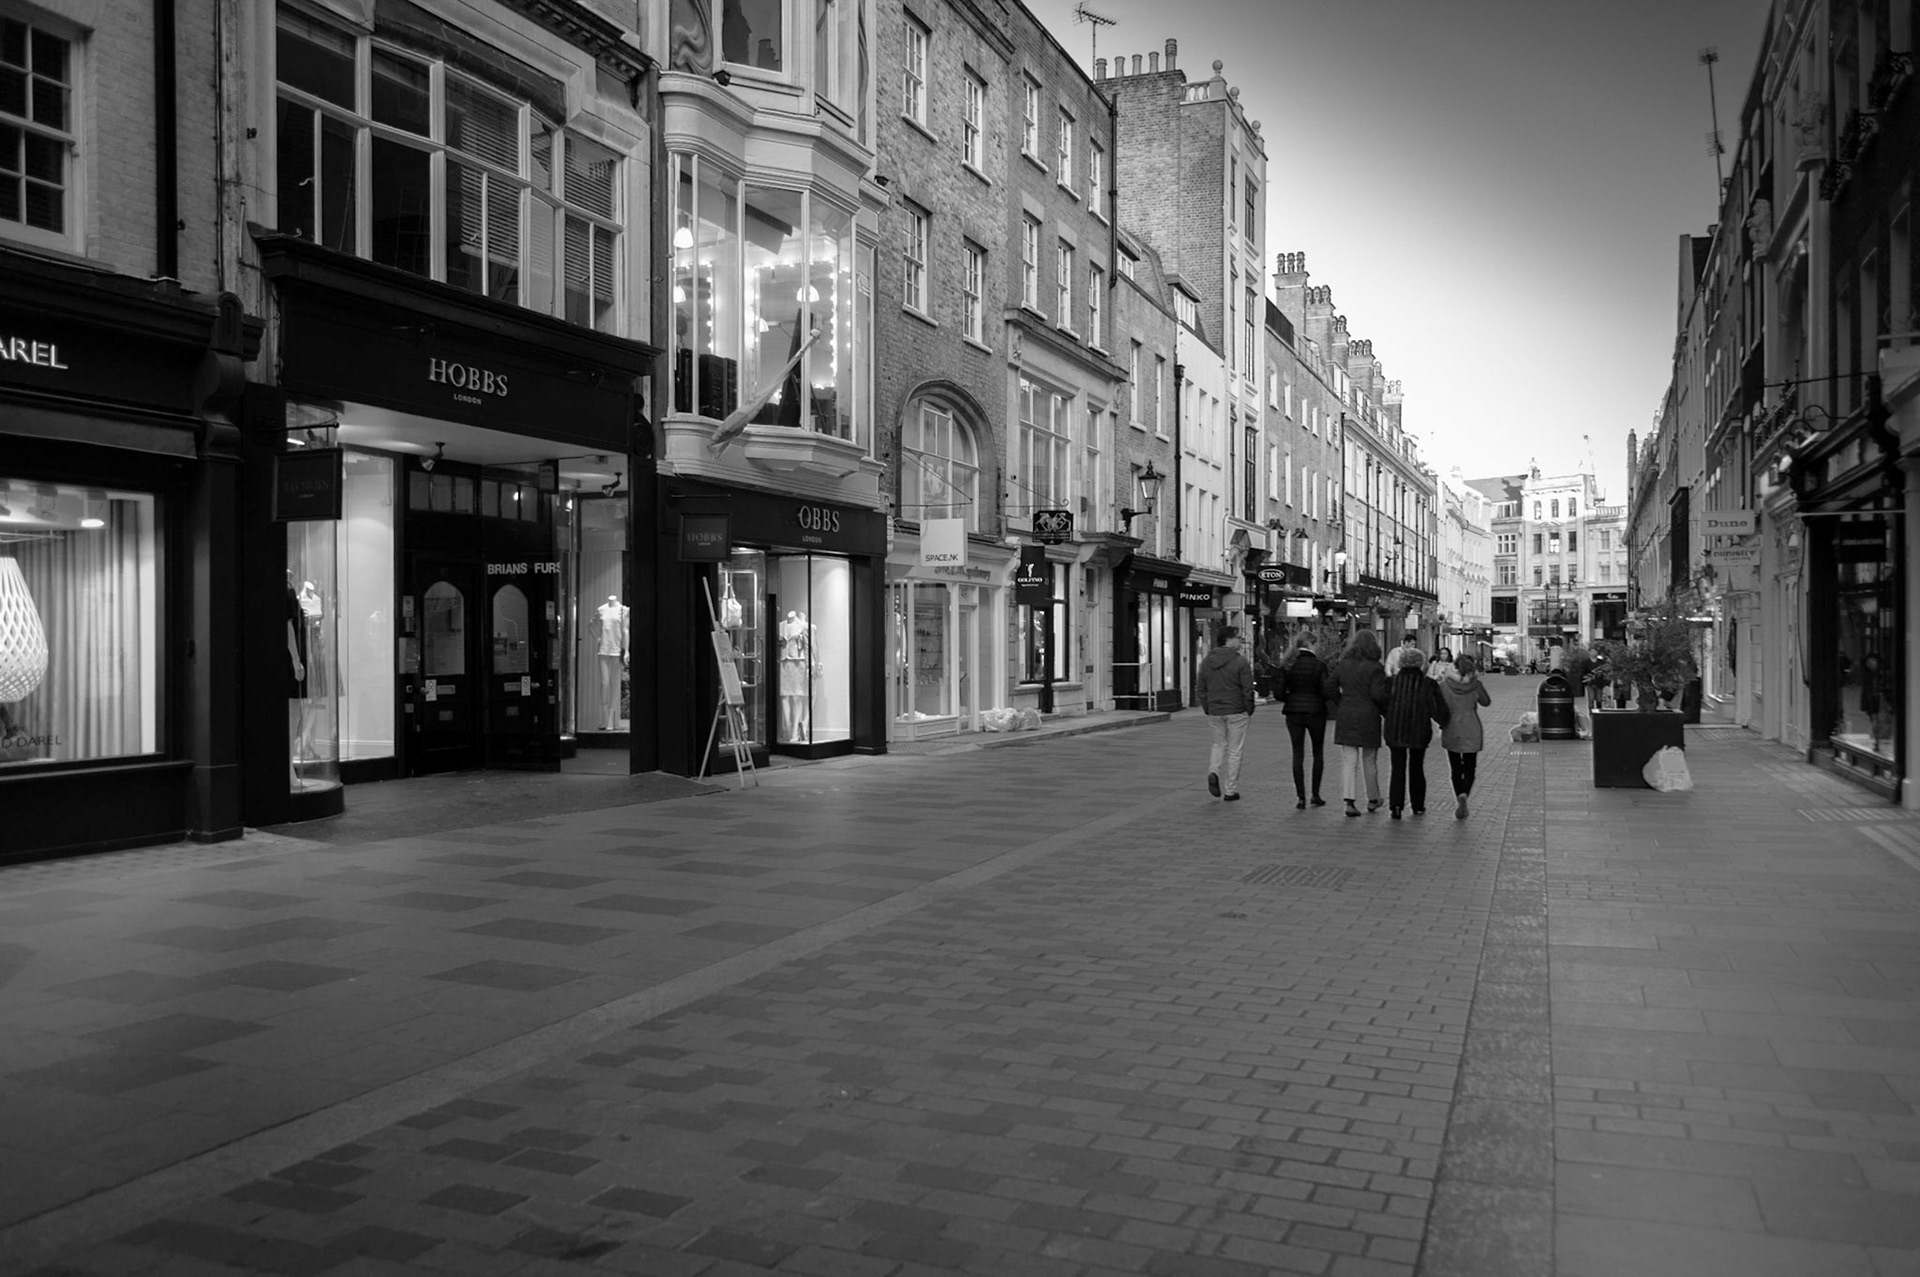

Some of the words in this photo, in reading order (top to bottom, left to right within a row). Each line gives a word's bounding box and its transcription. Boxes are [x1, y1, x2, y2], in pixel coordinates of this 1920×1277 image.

[428, 357, 508, 397] HOBBS
[453, 393, 483, 405] LONDON
[1707, 519, 1748, 528] Dune
[687, 532, 723, 542] HOBBS
[802, 535, 823, 544] LONDON
[487, 562, 528, 575] BRIANS
[1260, 571, 1282, 579] ETON
[1179, 592, 1211, 601] PINKO
[16, 735, 62, 748] DAREL
